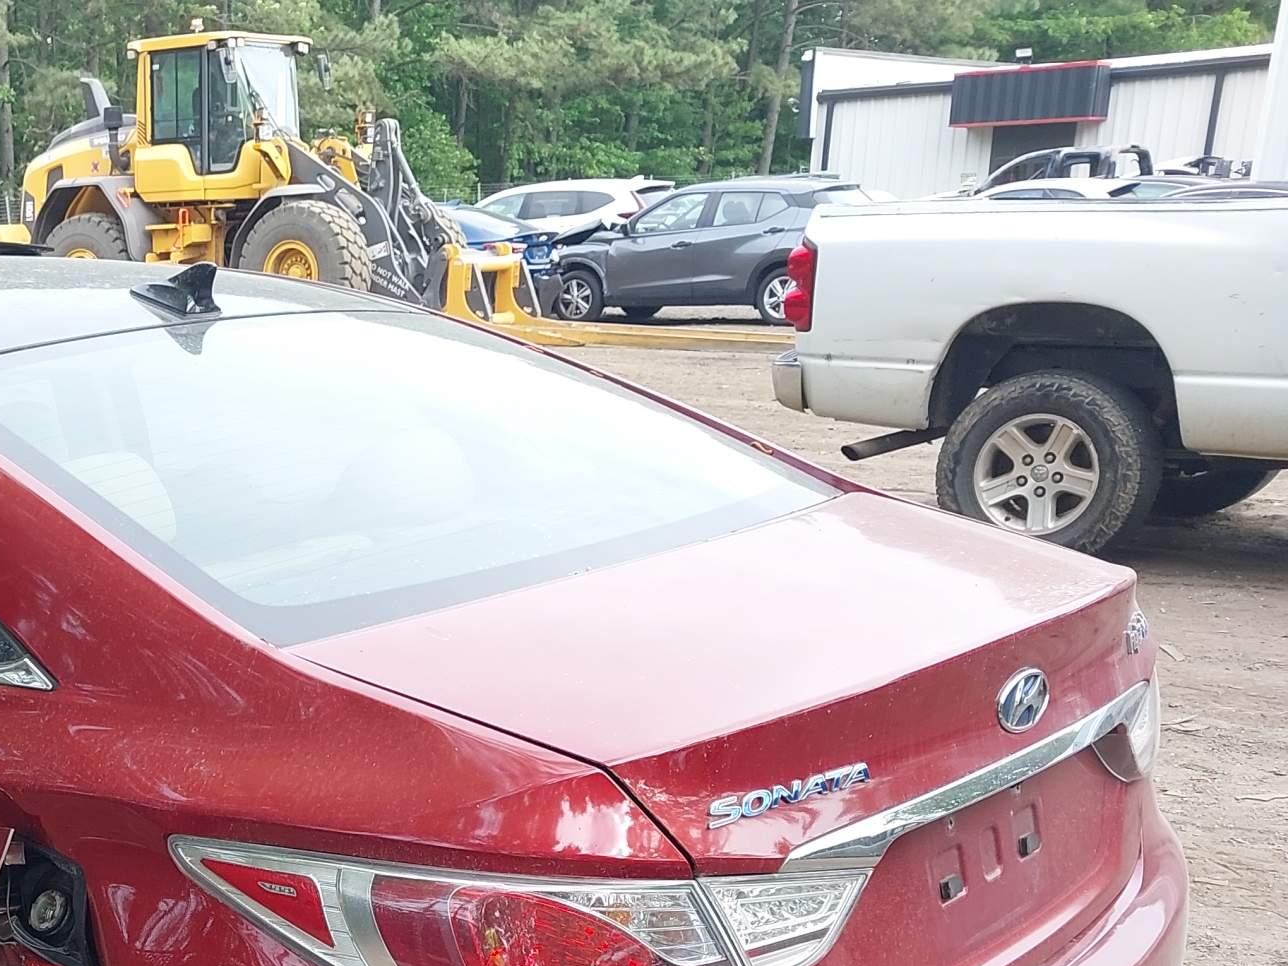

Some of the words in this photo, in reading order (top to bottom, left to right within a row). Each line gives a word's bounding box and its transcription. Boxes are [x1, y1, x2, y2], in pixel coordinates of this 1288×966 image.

[377, 266, 392, 279] NOT
[392, 274, 410, 291] WALK
[709, 762, 870, 829] SONATA
